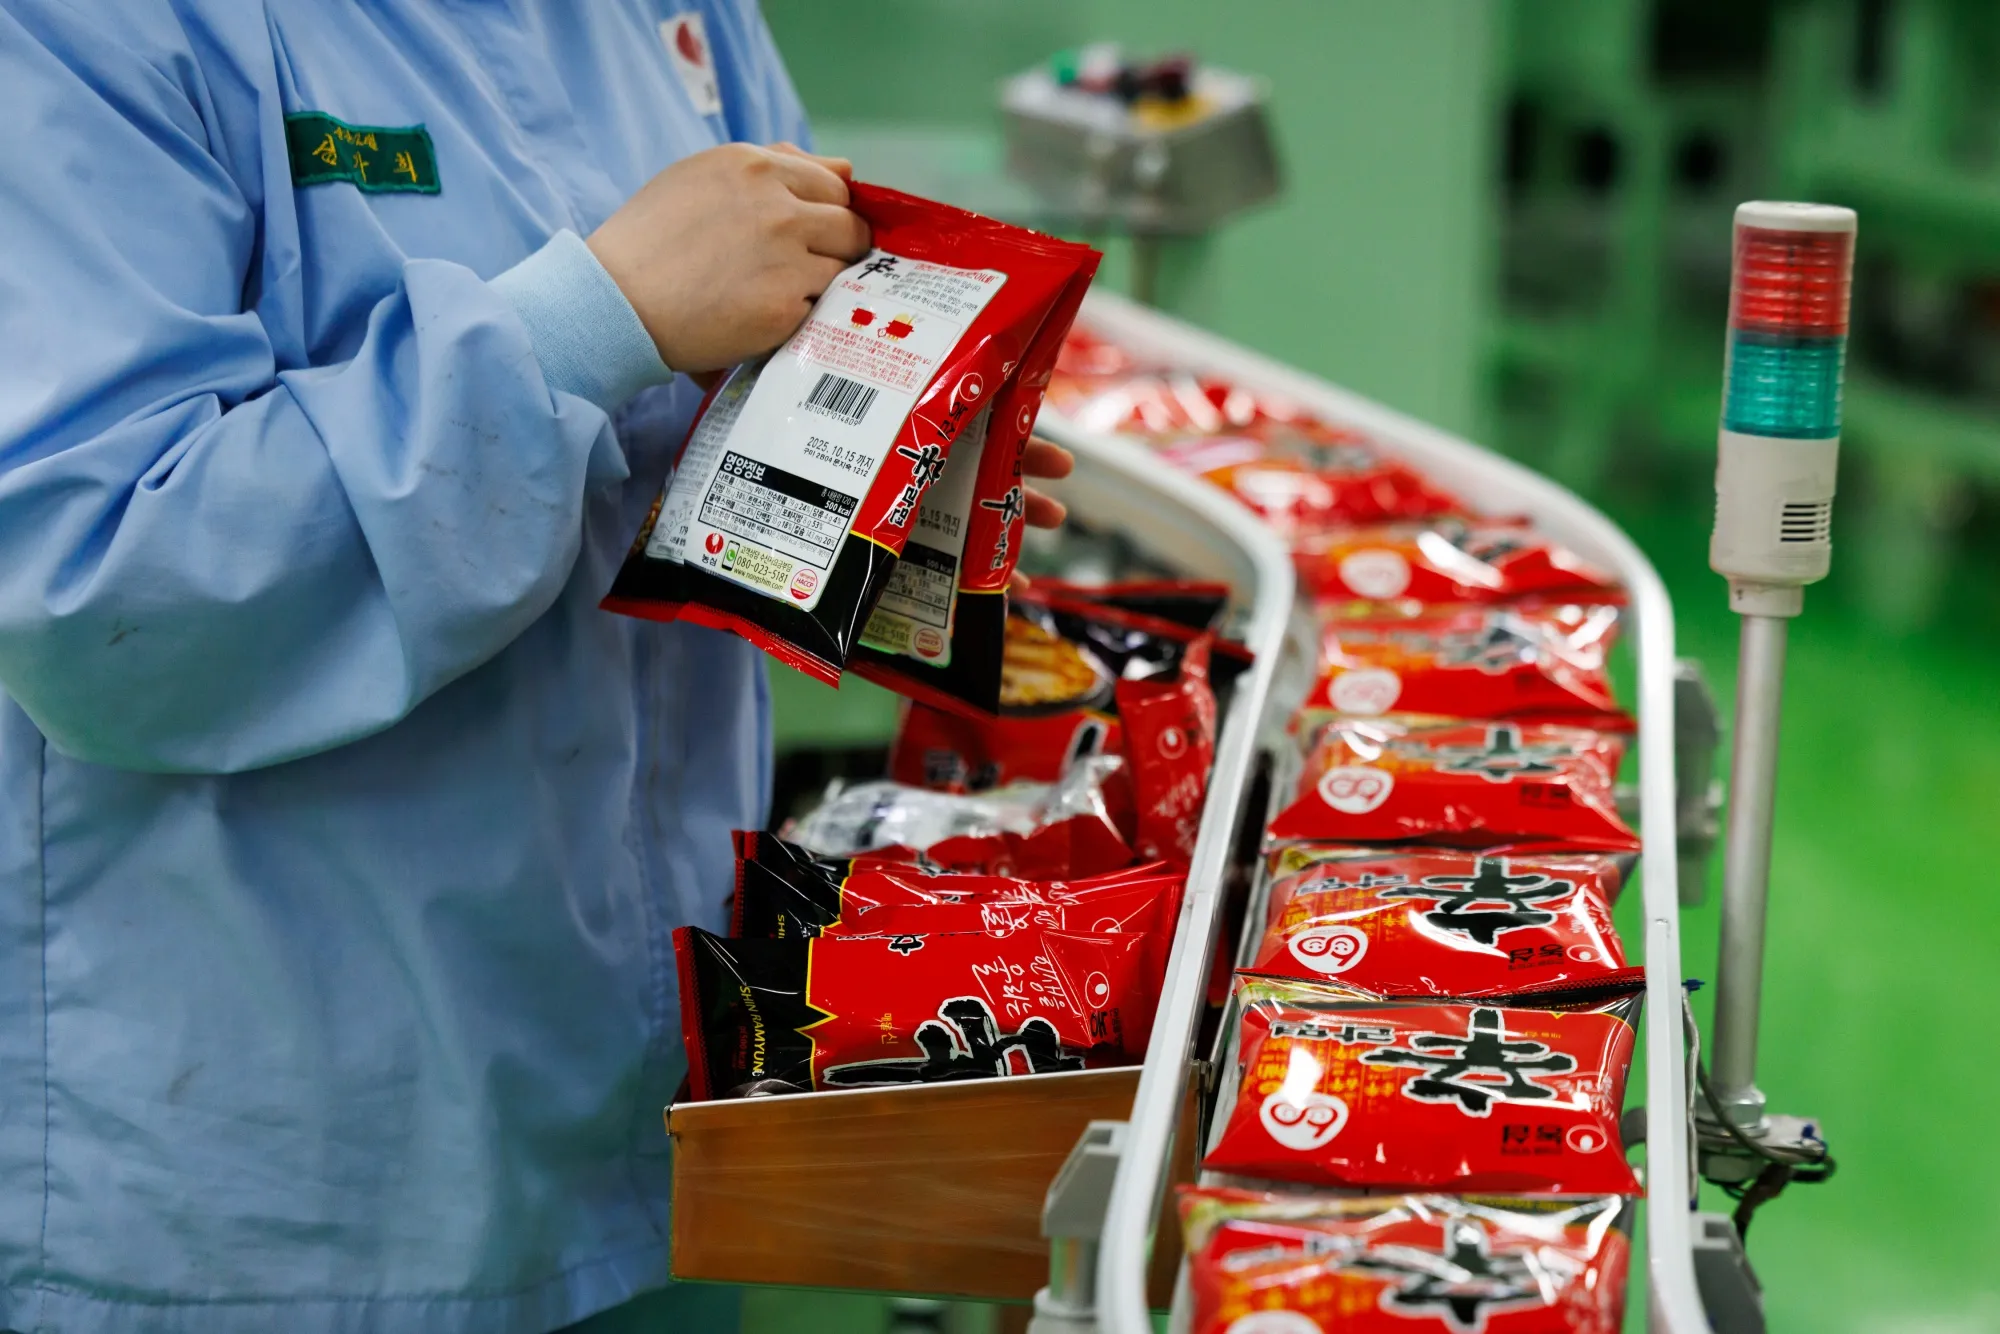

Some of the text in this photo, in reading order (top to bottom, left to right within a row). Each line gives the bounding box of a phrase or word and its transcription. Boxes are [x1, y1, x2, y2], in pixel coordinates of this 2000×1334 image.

[803, 403, 831, 417] 801043
[830, 411, 860, 426] 014809
[722, 453, 767, 482] 영양정보
[855, 454, 874, 469] 까지
[717, 473, 734, 484] 나트륨
[852, 466, 868, 476] 1212
[713, 483, 724, 493] 지방
[746, 496, 772, 510] 트랜스지방
[766, 491, 787, 504] 탄수화물
[888, 484, 919, 527] 라면
[781, 509, 803, 522] 포화지방
[812, 508, 823, 518] 당류
[824, 500, 851, 516] 500 kcal
[755, 511, 771, 522] 단백질
[793, 526, 805, 535] 칼슘
[701, 554, 717, 566] 농심
[735, 556, 788, 583] 080-023-5181
[796, 577, 813, 588] HACCP
[1297, 933, 1361, 967] 60
[1509, 944, 1563, 964] 농심
[971, 955, 1032, 1019] 울리는
[1029, 954, 1066, 1010] 인생을
[739, 985, 766, 1073] SHIN RAMYUN
[880, 1012, 899, 1045] 매울 신
[1270, 1018, 1397, 1045] 라면
[1359, 1006, 1579, 1118] 辛
